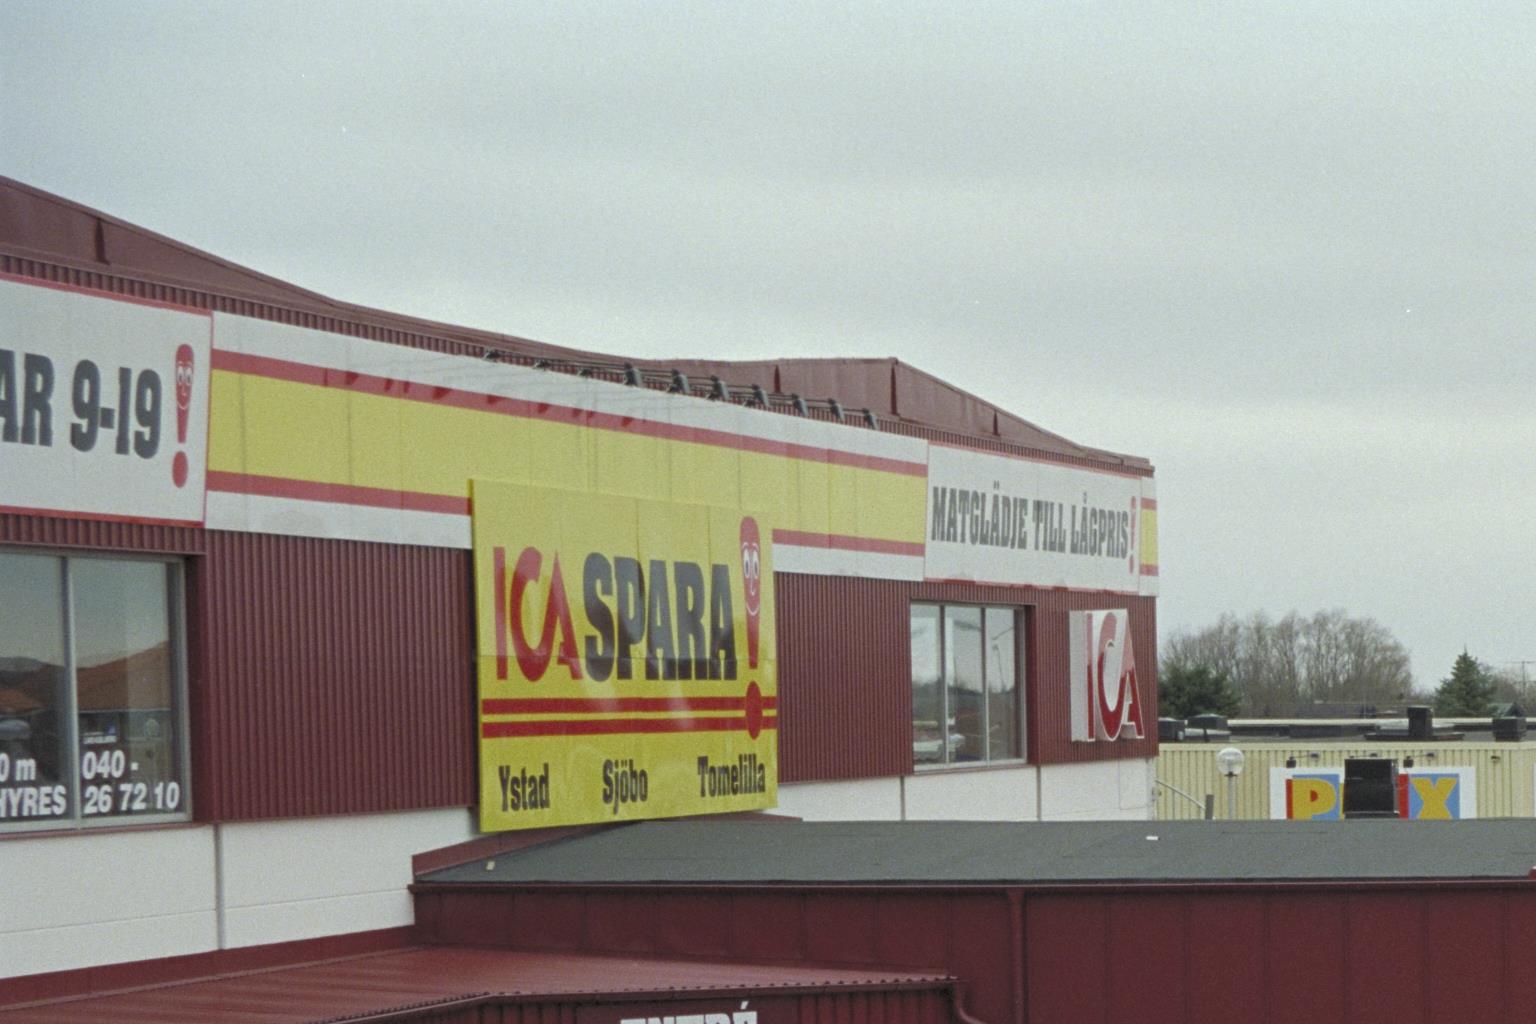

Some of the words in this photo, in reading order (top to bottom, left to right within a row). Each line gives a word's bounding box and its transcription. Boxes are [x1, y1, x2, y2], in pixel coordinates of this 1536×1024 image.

[931, 480, 1028, 549] MATGLÄDJE
[1032, 499, 1066, 553] TILL
[493, 546, 584, 683] ICA
[1086, 611, 1145, 742] ICA
[16, 758, 36, 781] m
[82, 750, 125, 780] 040
[498, 763, 550, 812] Ystad
[603, 758, 648, 815] Sjöbo
[697, 753, 766, 798] Tomelilla
[84, 785, 113, 814] 26
[120, 782, 148, 811] 72
[154, 781, 180, 809] 10
